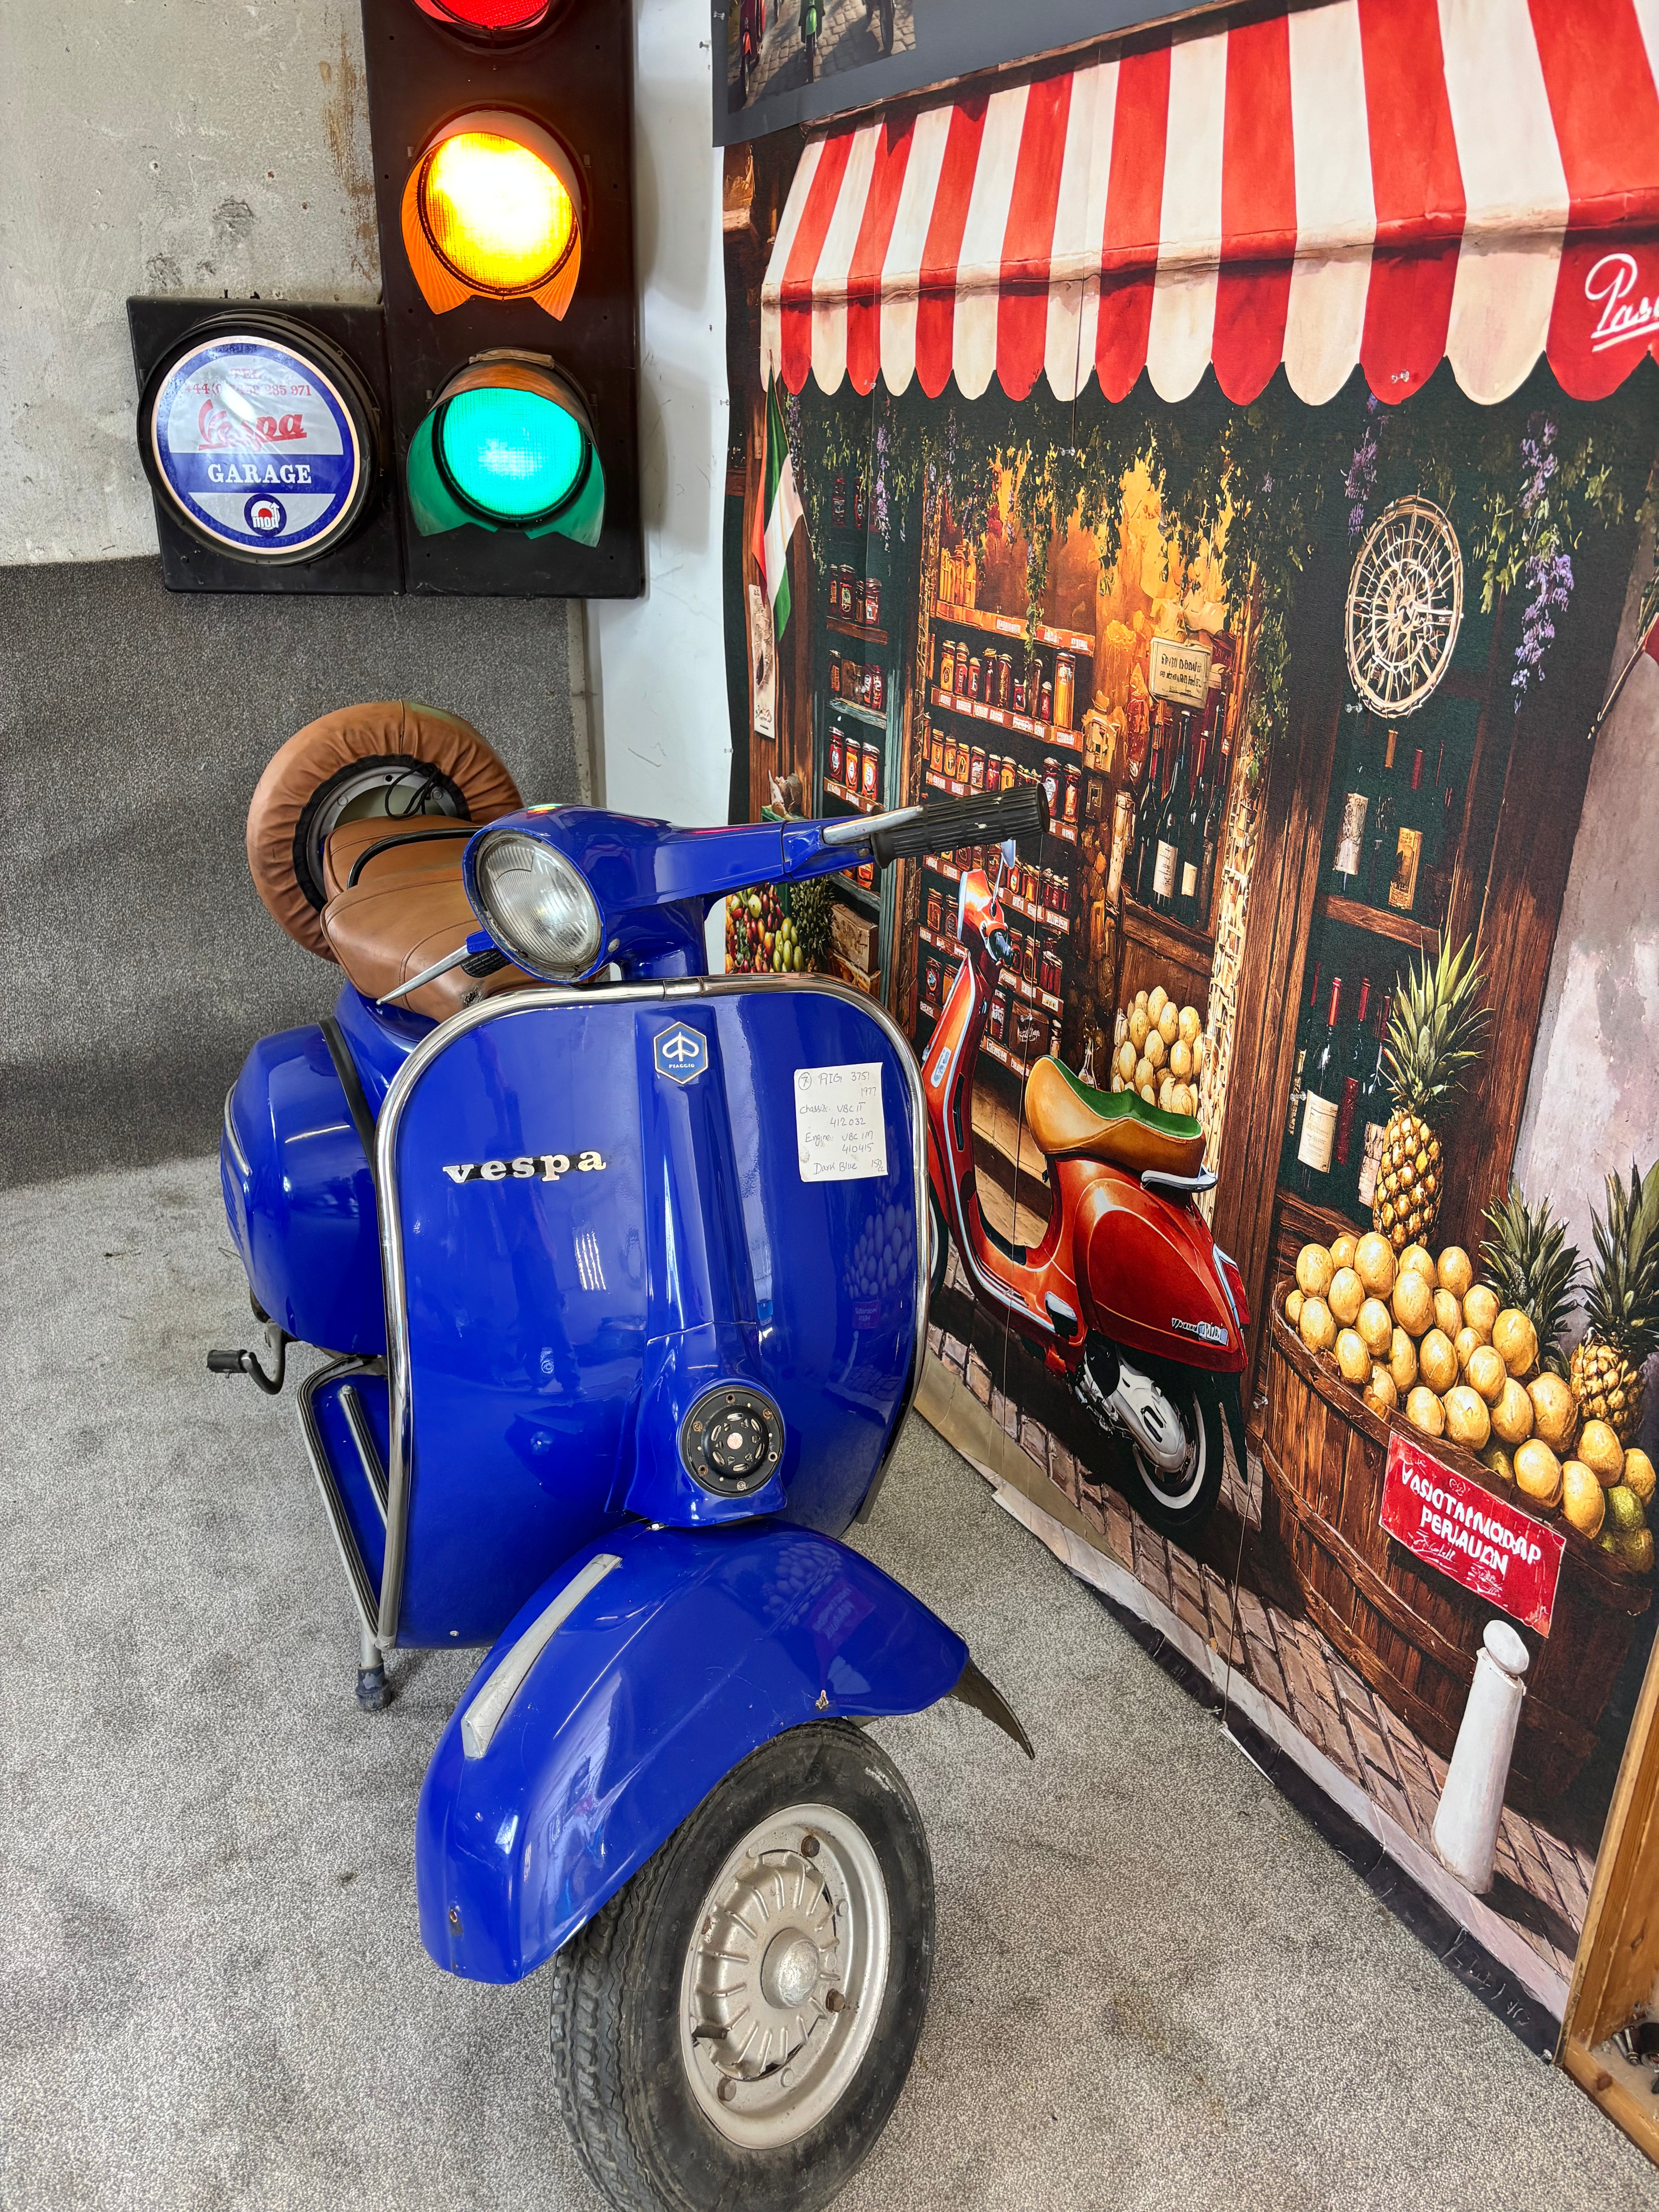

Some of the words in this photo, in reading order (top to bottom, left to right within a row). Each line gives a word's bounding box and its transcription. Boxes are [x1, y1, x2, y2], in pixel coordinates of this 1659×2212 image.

[290, 385, 312, 396] 971
[207, 464, 311, 484] GARAGE
[851, 1071, 870, 1081] 3751
[861, 1087, 876, 1097] 1977
[842, 1143, 874, 1154] 410415
[443, 1151, 607, 1183] vespa
[813, 1162, 835, 1175] Dark
[839, 1162, 857, 1172] Blue
